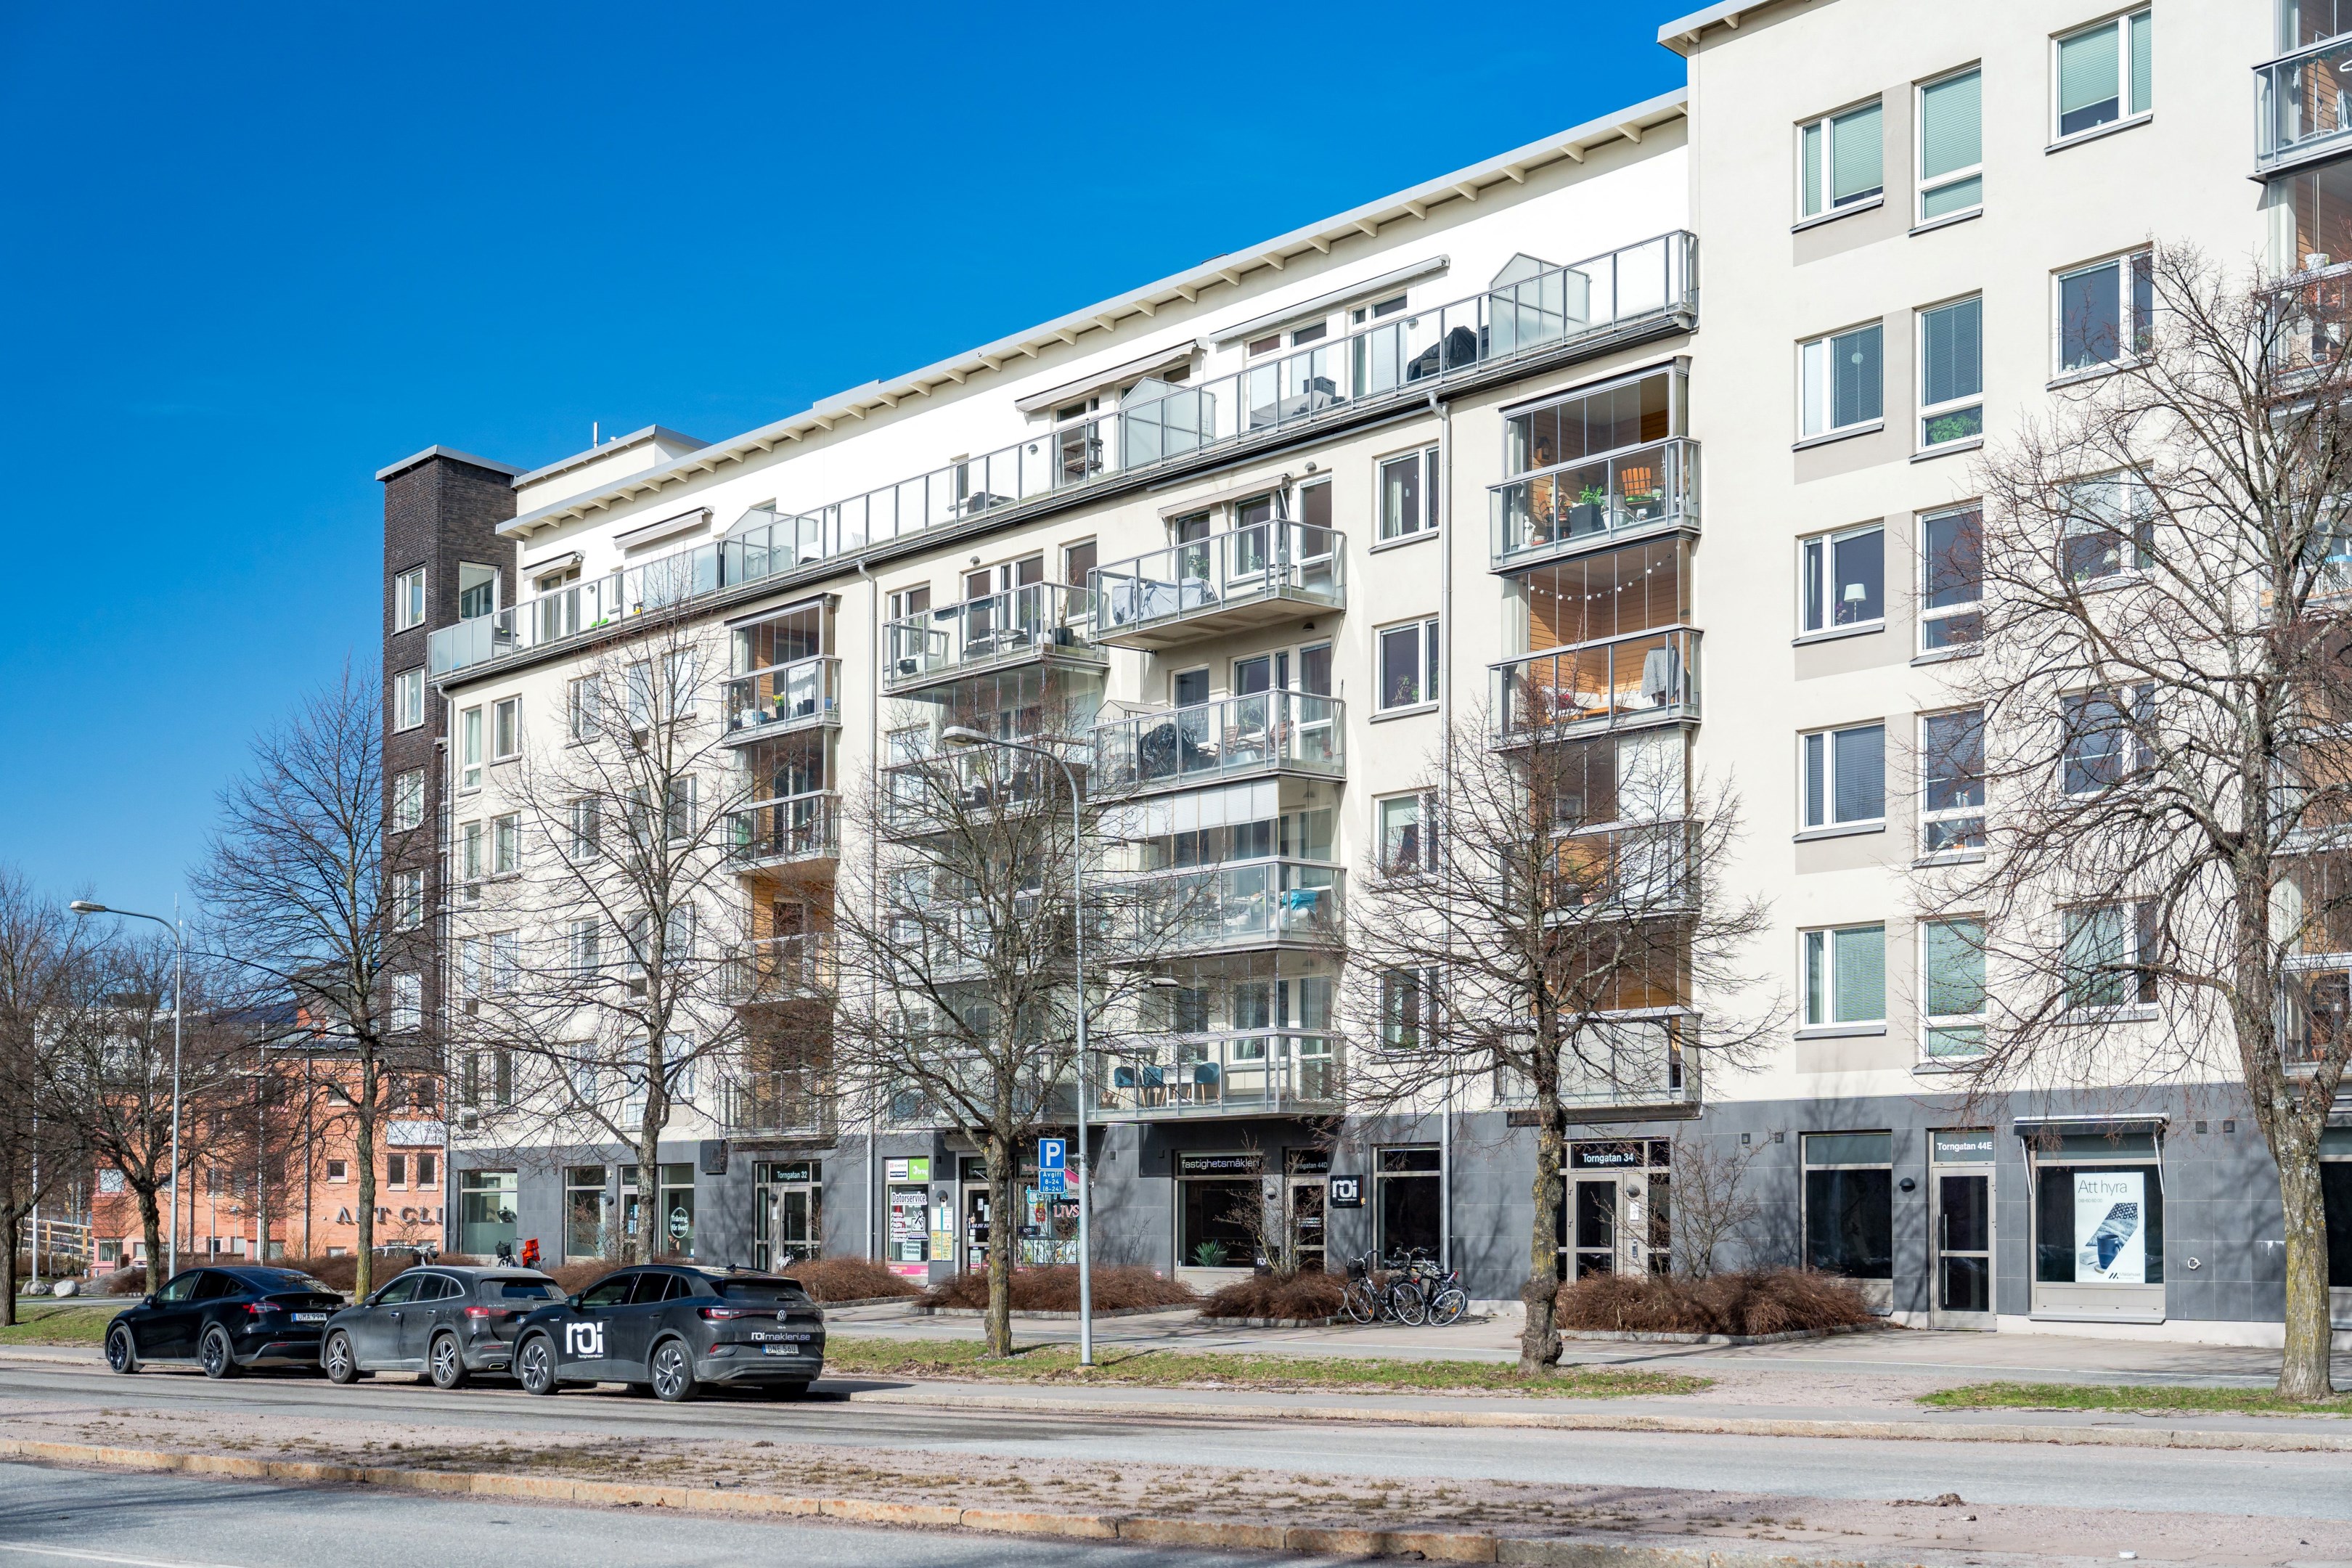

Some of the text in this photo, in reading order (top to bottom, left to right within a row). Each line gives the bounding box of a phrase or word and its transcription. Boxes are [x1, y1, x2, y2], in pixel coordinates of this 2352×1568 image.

[1937, 1143, 1976, 1152] Torngatan
[1046, 1142, 1061, 1167] P
[1583, 1153, 1634, 1164] Torngatan 34
[1182, 1158, 1259, 1169] fastighetsmäkleri
[777, 1171, 800, 1180] Torngatan
[2078, 1180, 2127, 1196] Att hyra
[892, 1192, 926, 1203] Datorservice
